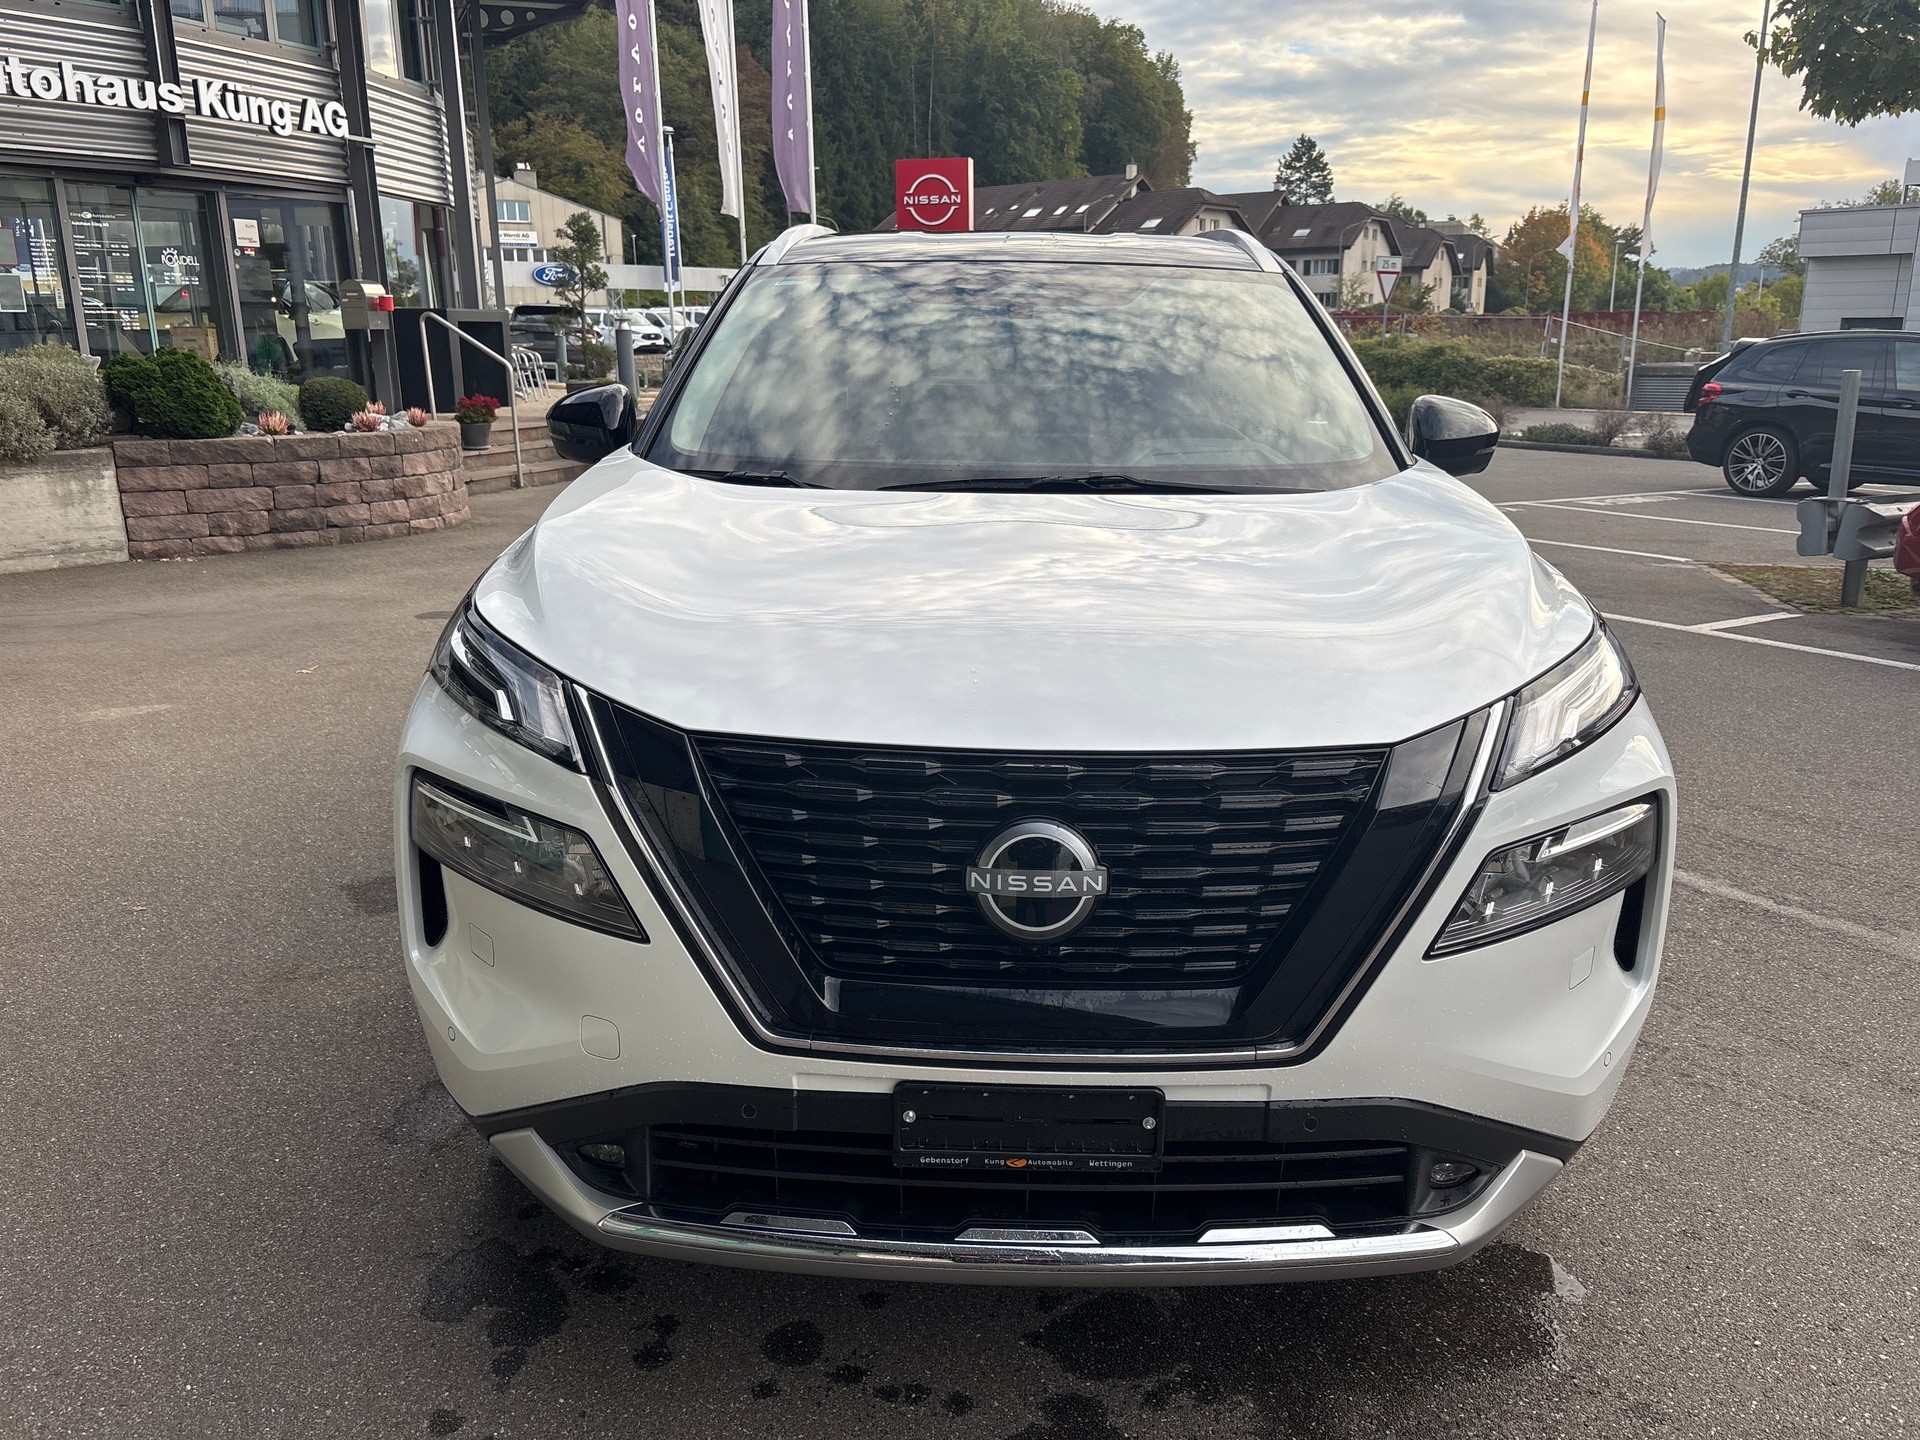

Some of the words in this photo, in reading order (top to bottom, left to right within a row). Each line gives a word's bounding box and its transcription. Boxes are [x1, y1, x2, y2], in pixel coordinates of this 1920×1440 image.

[195, 78, 292, 136] Küng
[301, 98, 348, 139] AG
[903, 194, 961, 205] NISSAN
[1382, 260, 1390, 270] 25
[970, 872, 1102, 893] NISSAN
[920, 1156, 970, 1165] Gebenstorf
[1089, 1159, 1133, 1168] Wettingen
